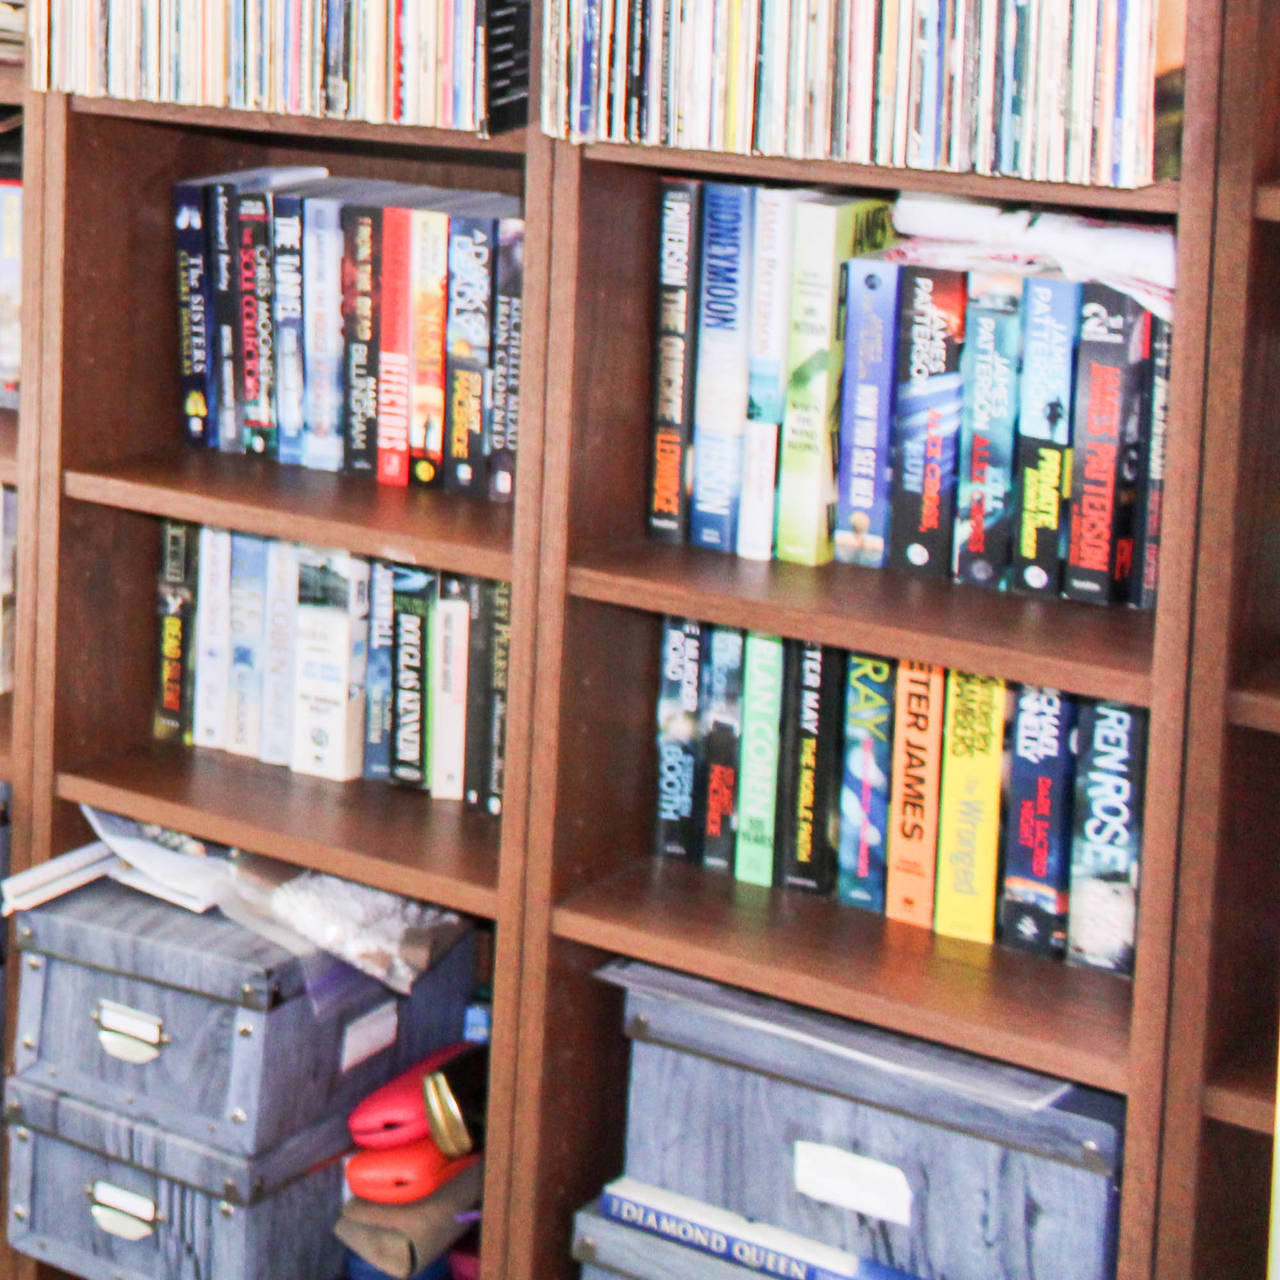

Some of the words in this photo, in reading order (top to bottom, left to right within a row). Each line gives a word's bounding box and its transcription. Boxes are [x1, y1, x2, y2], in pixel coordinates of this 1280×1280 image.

[190, 254, 204, 289] The
[704, 193, 743, 332] HONEYMOON
[190, 293, 207, 374] SISTERS
[495, 295, 510, 347] IRON
[928, 310, 947, 374] JAMES
[351, 342, 369, 450] BILLINGHAM
[378, 351, 409, 452] DEFECTORS
[972, 316, 995, 431] PATTERSON
[989, 351, 1011, 419] JAMES
[1078, 441, 1117, 572] PATTERSON
[397, 613, 421, 689] DOUGLAS
[748, 640, 779, 715] RLAN
[803, 649, 822, 688] TER
[800, 690, 820, 735] MAY
[848, 656, 890, 741] RAY
[908, 661, 932, 732] ETER
[976, 681, 999, 756] imberley
[746, 720, 776, 816] COBEN
[1093, 706, 1132, 772] REN
[658, 744, 684, 821] BOOTH
[901, 738, 927, 841] JAMES
[949, 799, 985, 896] Wronged
[1083, 772, 1132, 873] ROSE
[620, 1202, 728, 1255] DIAMOND
[732, 1241, 809, 1279] QUEEN
